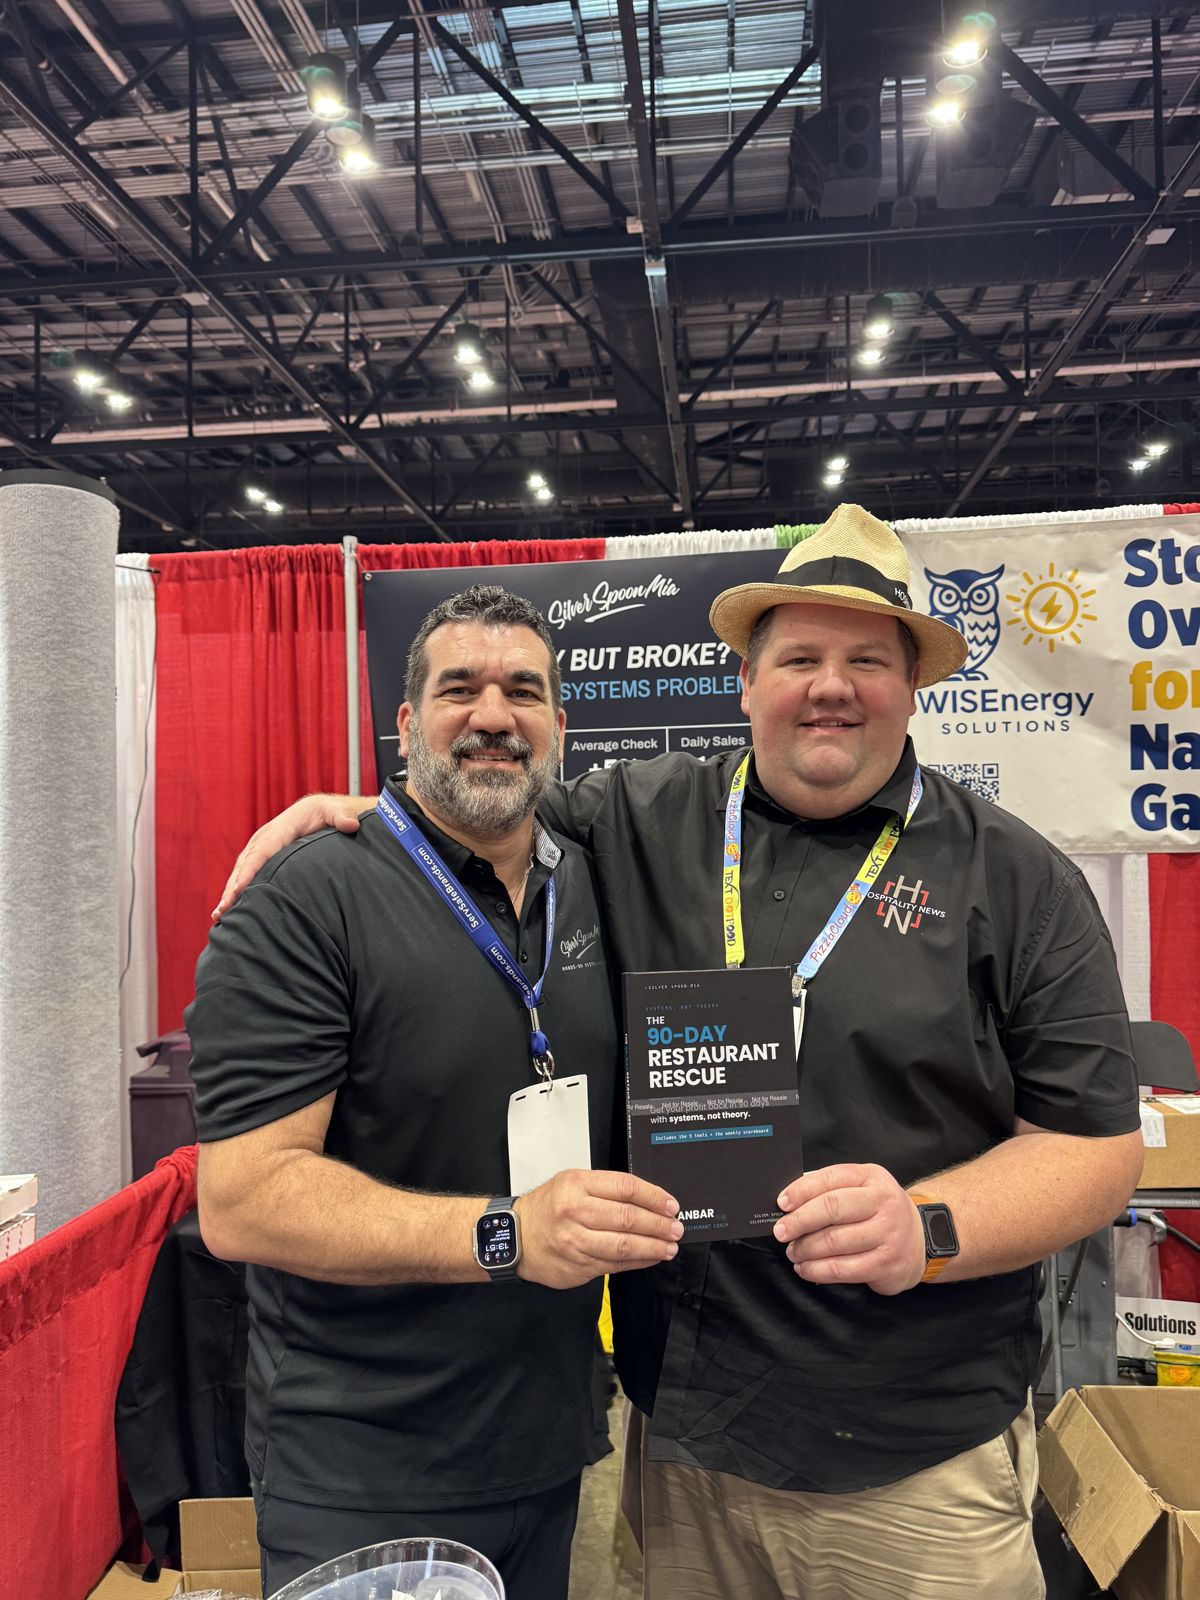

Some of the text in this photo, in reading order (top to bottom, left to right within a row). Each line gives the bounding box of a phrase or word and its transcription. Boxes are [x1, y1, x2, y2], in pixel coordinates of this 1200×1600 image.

[548, 573, 681, 630] Silver Spoon Mia
[570, 647, 622, 672] BUT
[626, 642, 731, 670] BROKE?
[560, 679, 650, 701] SYSTEMS
[917, 689, 1095, 717] WISEnergy
[941, 720, 1070, 735] SOLUTIONS
[571, 738, 658, 753] Average Check
[680, 735, 746, 749] Daily Sales
[1130, 723, 1200, 770] Na
[1131, 783, 1200, 831] Ga
[418, 847, 479, 928] ServSafeBrands.com
[725, 870, 733, 894] TEXT
[918, 905, 946, 918] NEWS
[810, 903, 852, 963] PizzaCloud
[646, 1016, 665, 1025] THE
[647, 1024, 727, 1046] 90-DAY
[648, 1043, 779, 1067] RESTAURANT
[649, 1067, 726, 1088] RESCUE
[650, 1105, 664, 1114] Get
[666, 1106, 683, 1116] your
[686, 1103, 706, 1114] profit
[750, 1099, 770, 1109] days
[650, 1111, 751, 1125] with systems, not theory.
[677, 1208, 714, 1220] ANBAR
[684, 1223, 711, 1231] ESTAURANT
[1124, 1312, 1197, 1336] Solutions
